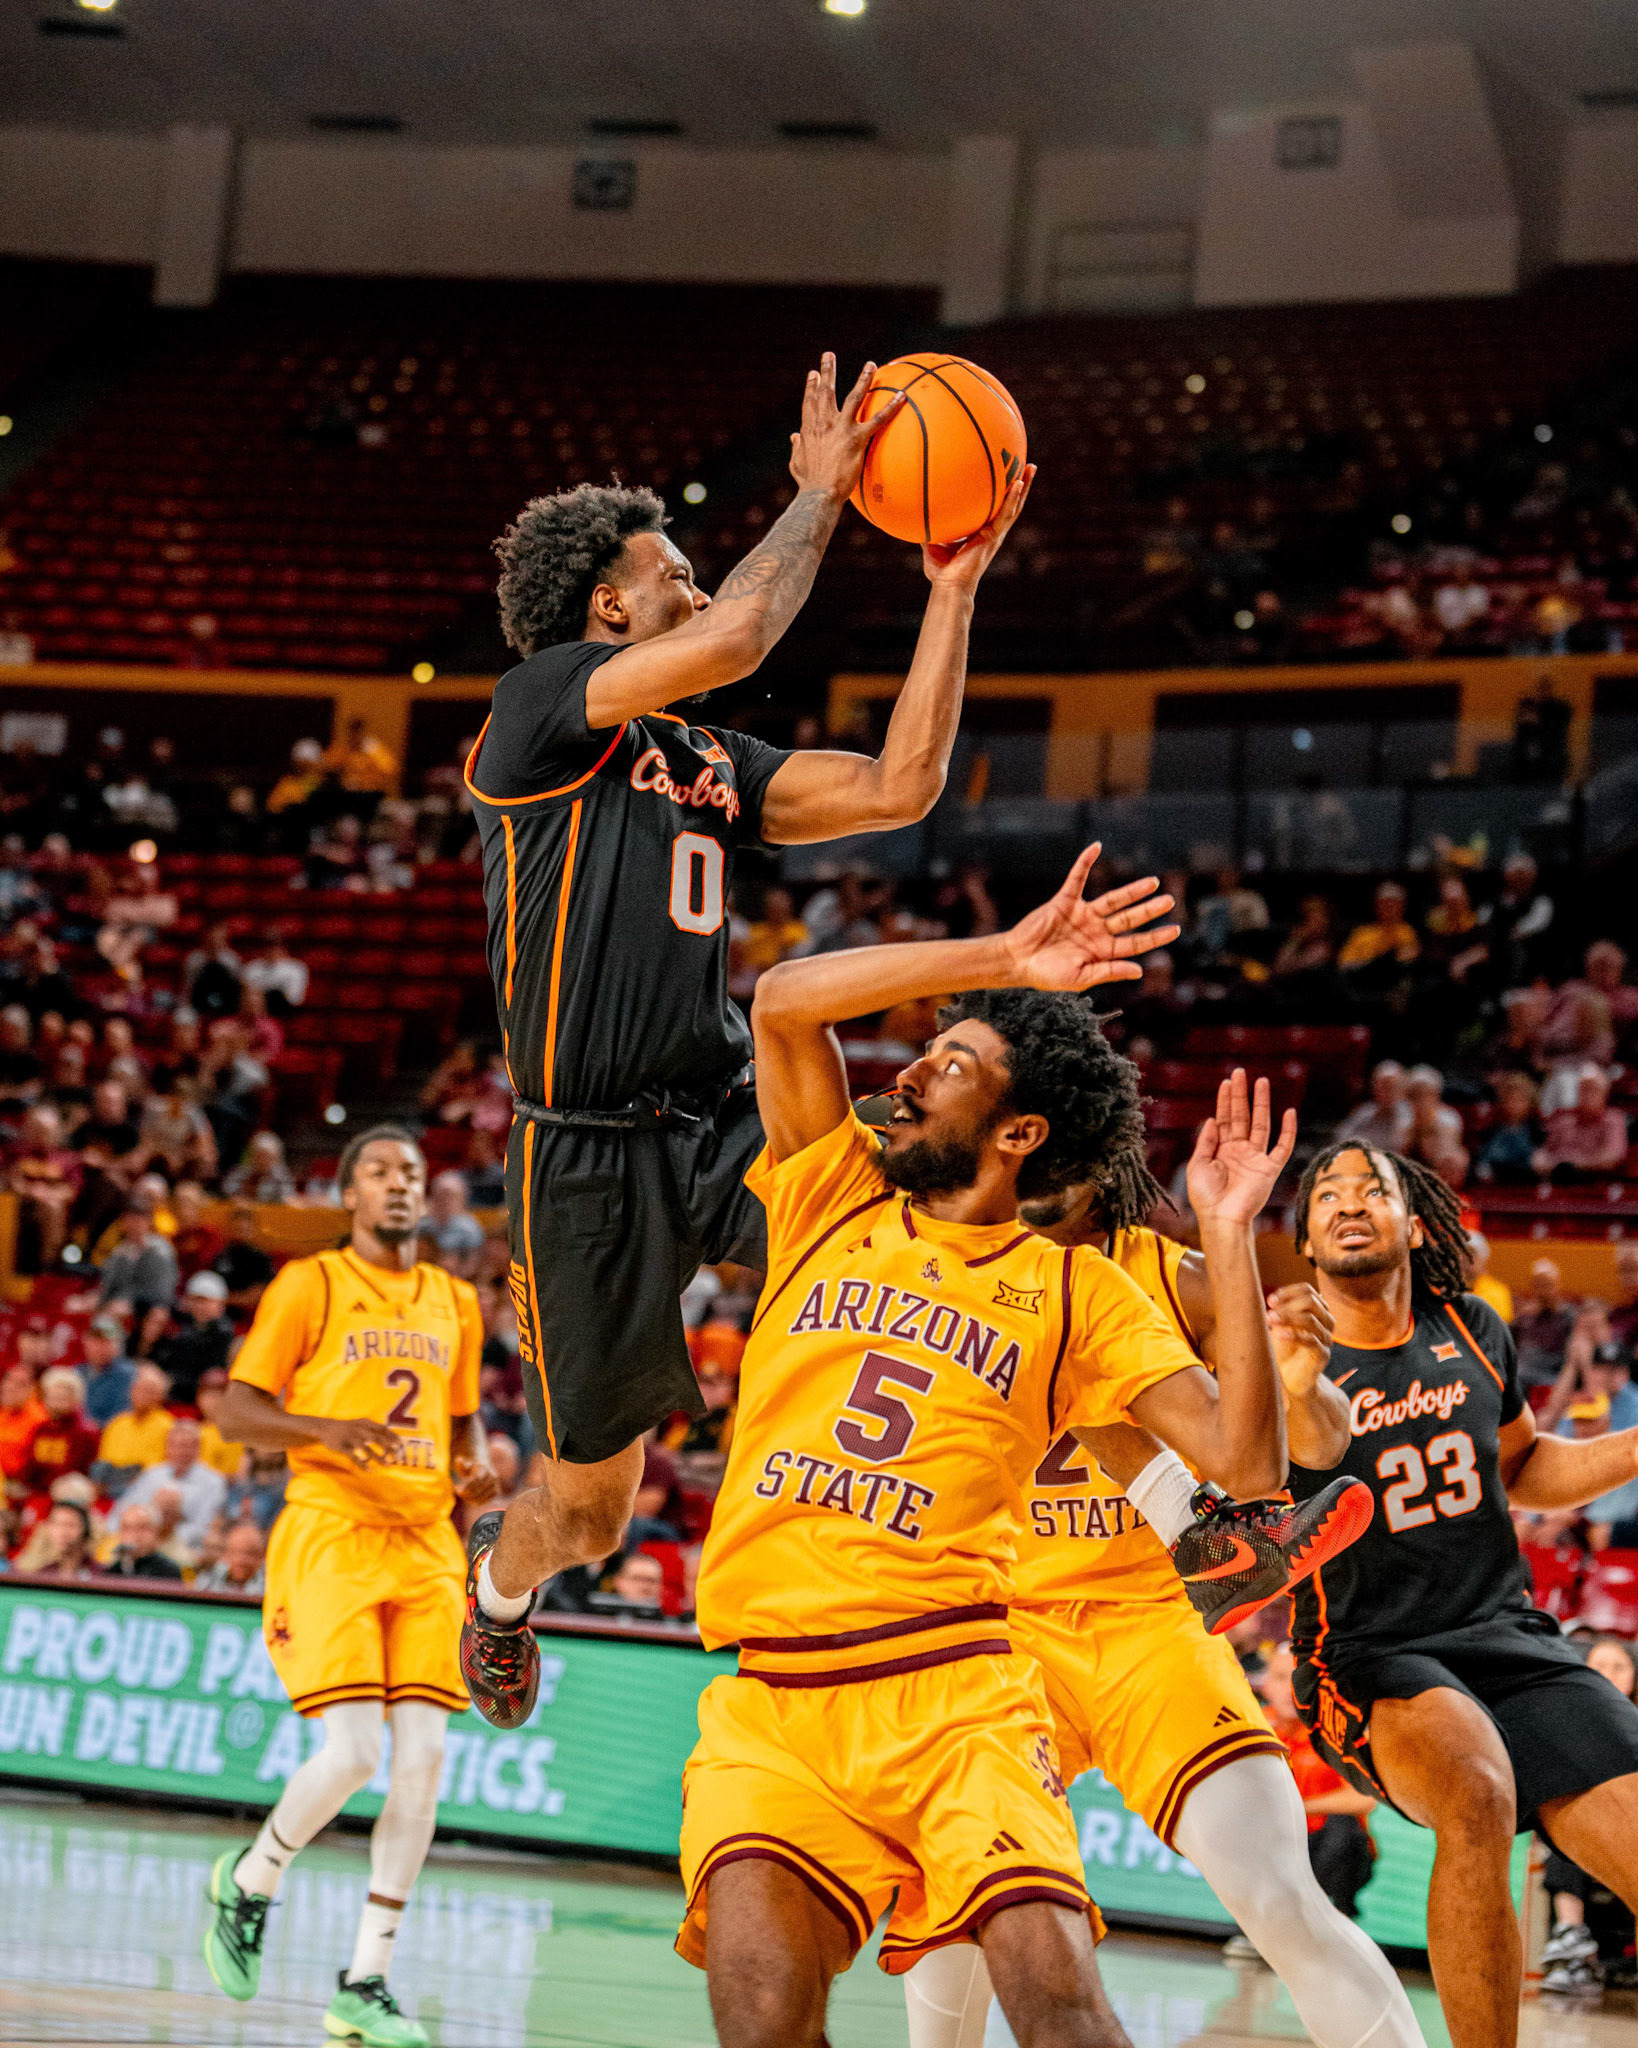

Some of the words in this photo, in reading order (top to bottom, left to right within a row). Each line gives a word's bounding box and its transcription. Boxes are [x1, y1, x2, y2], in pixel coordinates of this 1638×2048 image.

[668, 830, 725, 936] 0
[788, 1278, 1021, 1403] ARIZONA
[384, 1367, 421, 1430] 2
[832, 1348, 937, 1465] 5
[1350, 1379, 1471, 1437] Cowboys
[755, 1450, 936, 1542] STATE
[1375, 1429, 1483, 1534] 23
[3, 1604, 194, 1691] PROUD
